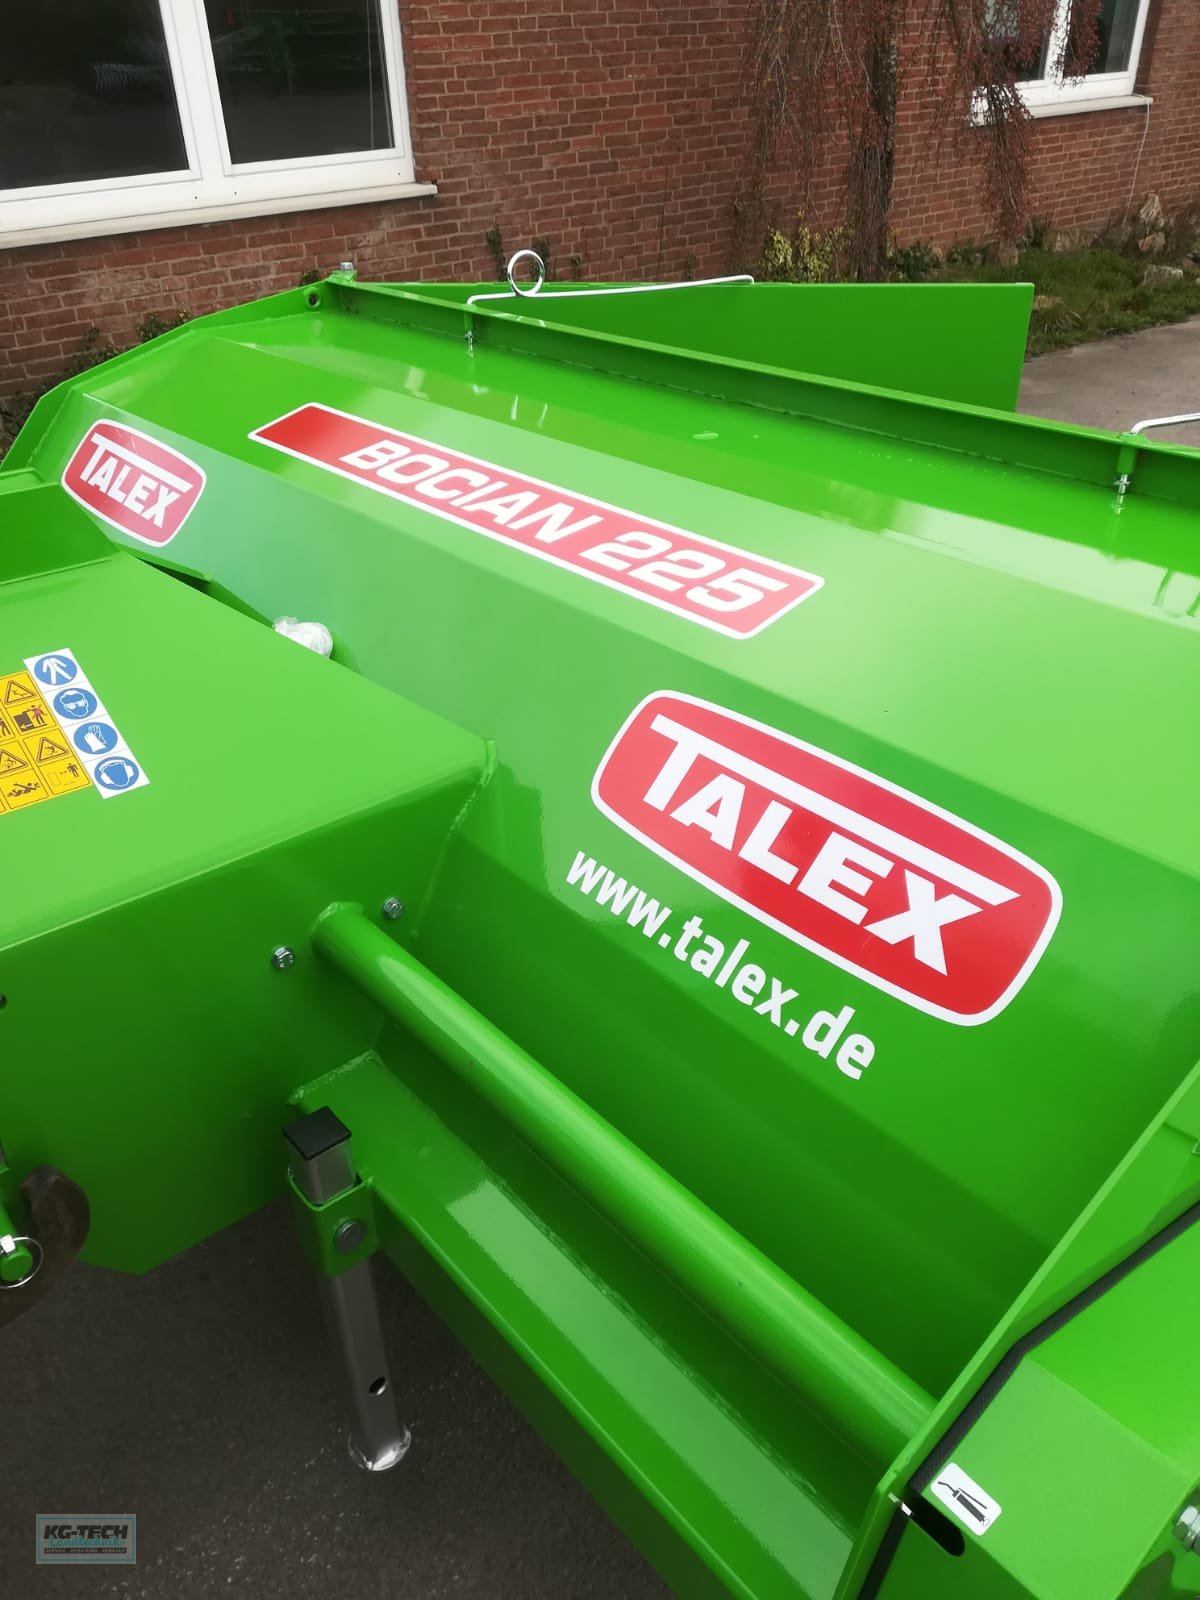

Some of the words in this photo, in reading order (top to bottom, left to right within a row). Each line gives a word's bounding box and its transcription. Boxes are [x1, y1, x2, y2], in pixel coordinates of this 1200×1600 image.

[79, 432, 194, 529] TALEX
[338, 439, 604, 545] BOCIAN
[578, 531, 790, 613] 225
[642, 713, 1022, 977] TALEX
[565, 850, 876, 1081] www.talex.de
